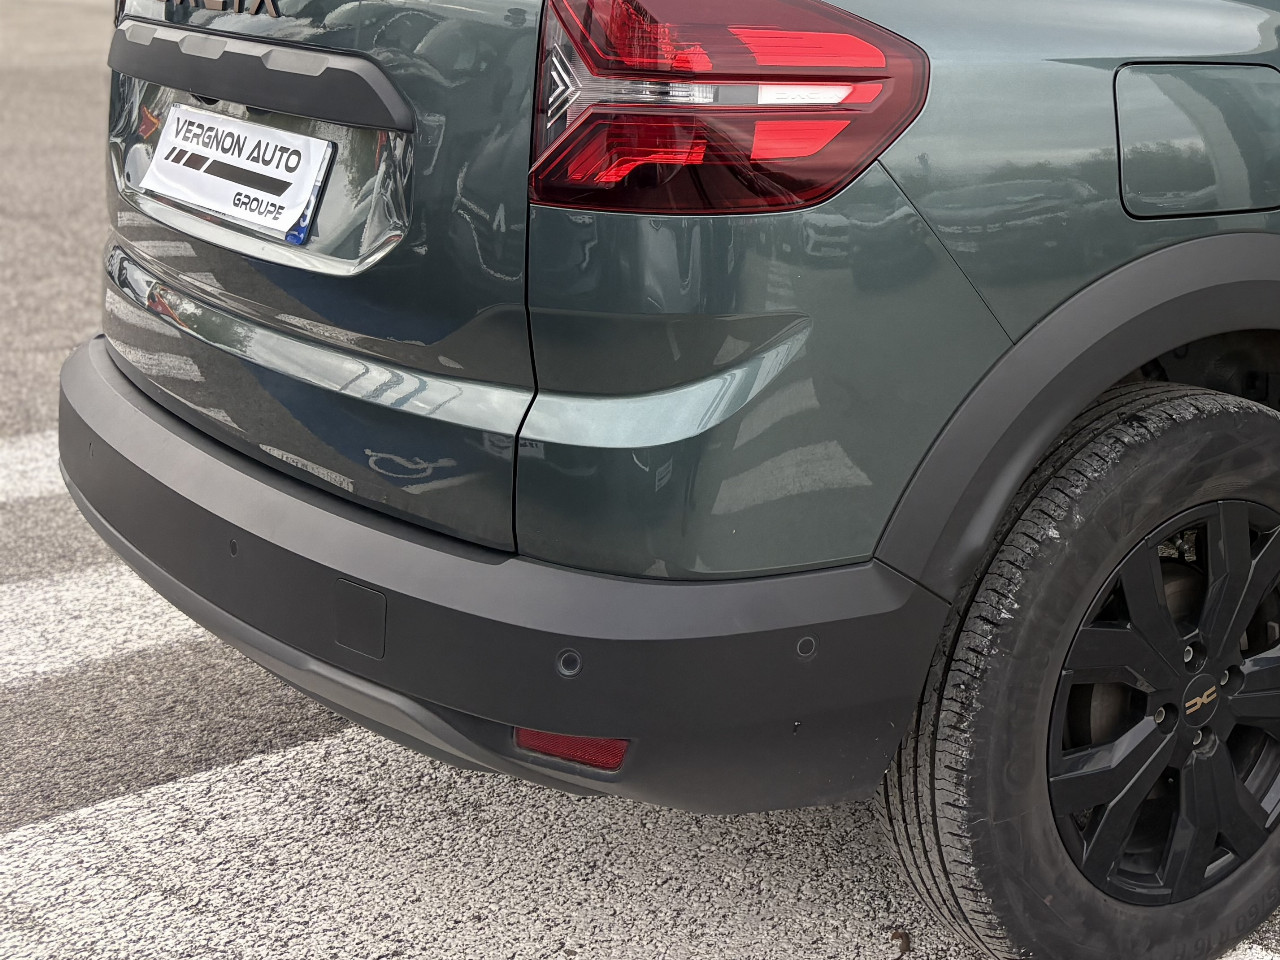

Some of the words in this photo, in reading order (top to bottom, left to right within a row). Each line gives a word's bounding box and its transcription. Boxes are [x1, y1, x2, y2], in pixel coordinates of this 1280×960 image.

[174, 117, 246, 157] VERGNON
[246, 139, 302, 174] AUTO
[232, 191, 286, 221] GROUPE
